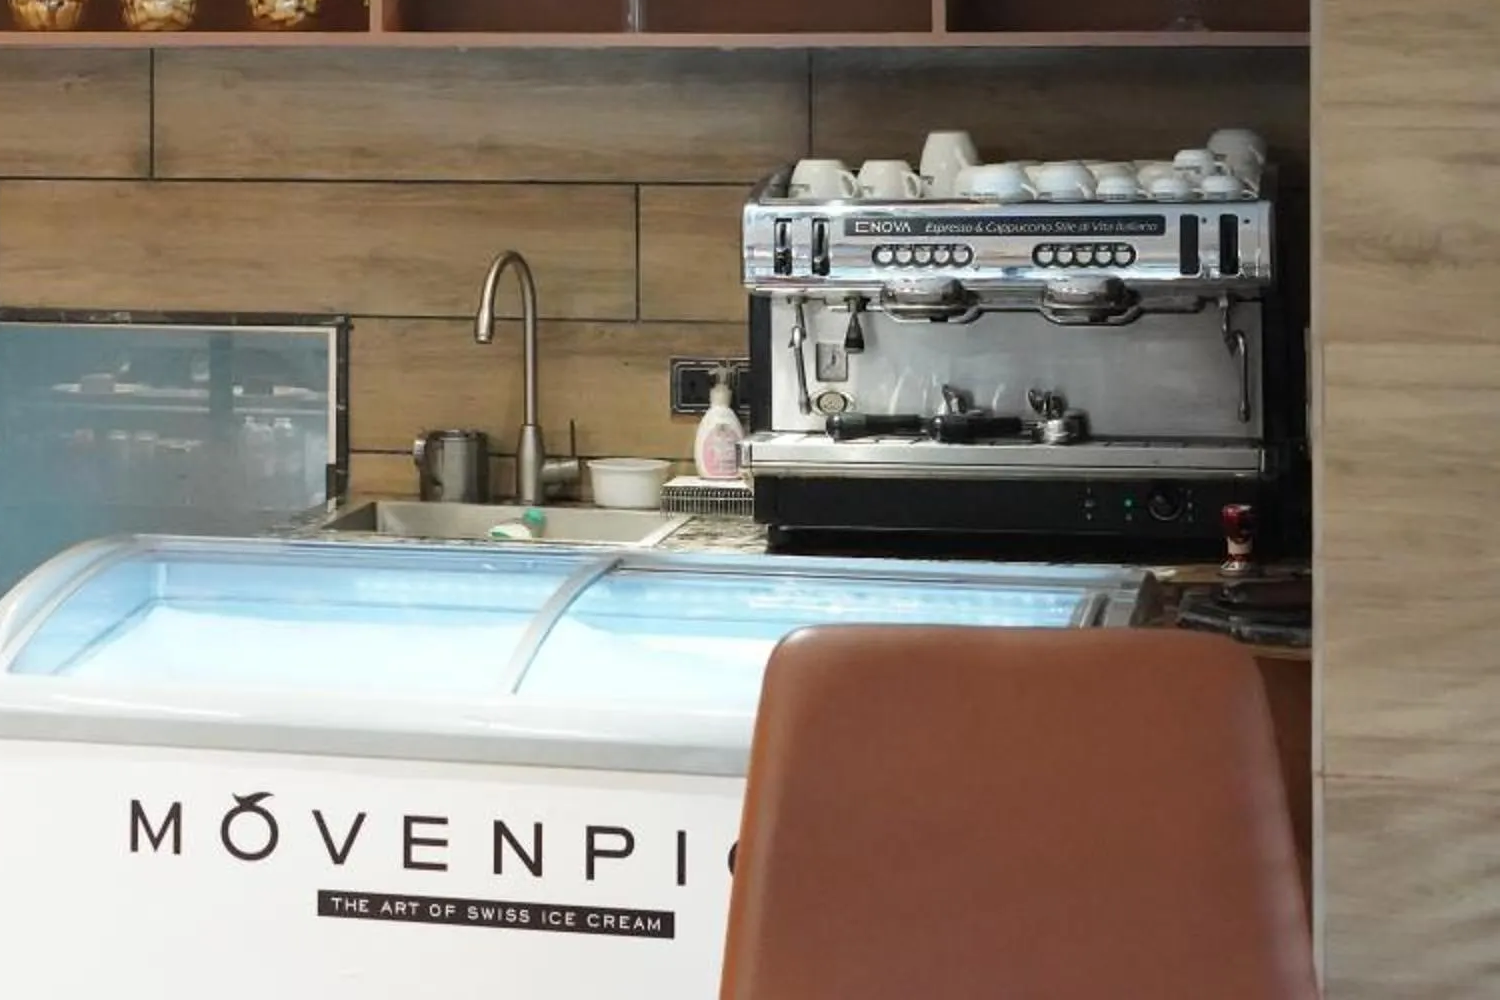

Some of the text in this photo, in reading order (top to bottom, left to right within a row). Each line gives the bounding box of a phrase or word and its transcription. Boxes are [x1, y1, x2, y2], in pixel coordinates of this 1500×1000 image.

[330, 895, 662, 932] THE ART OF SWISS ICE CREAM
